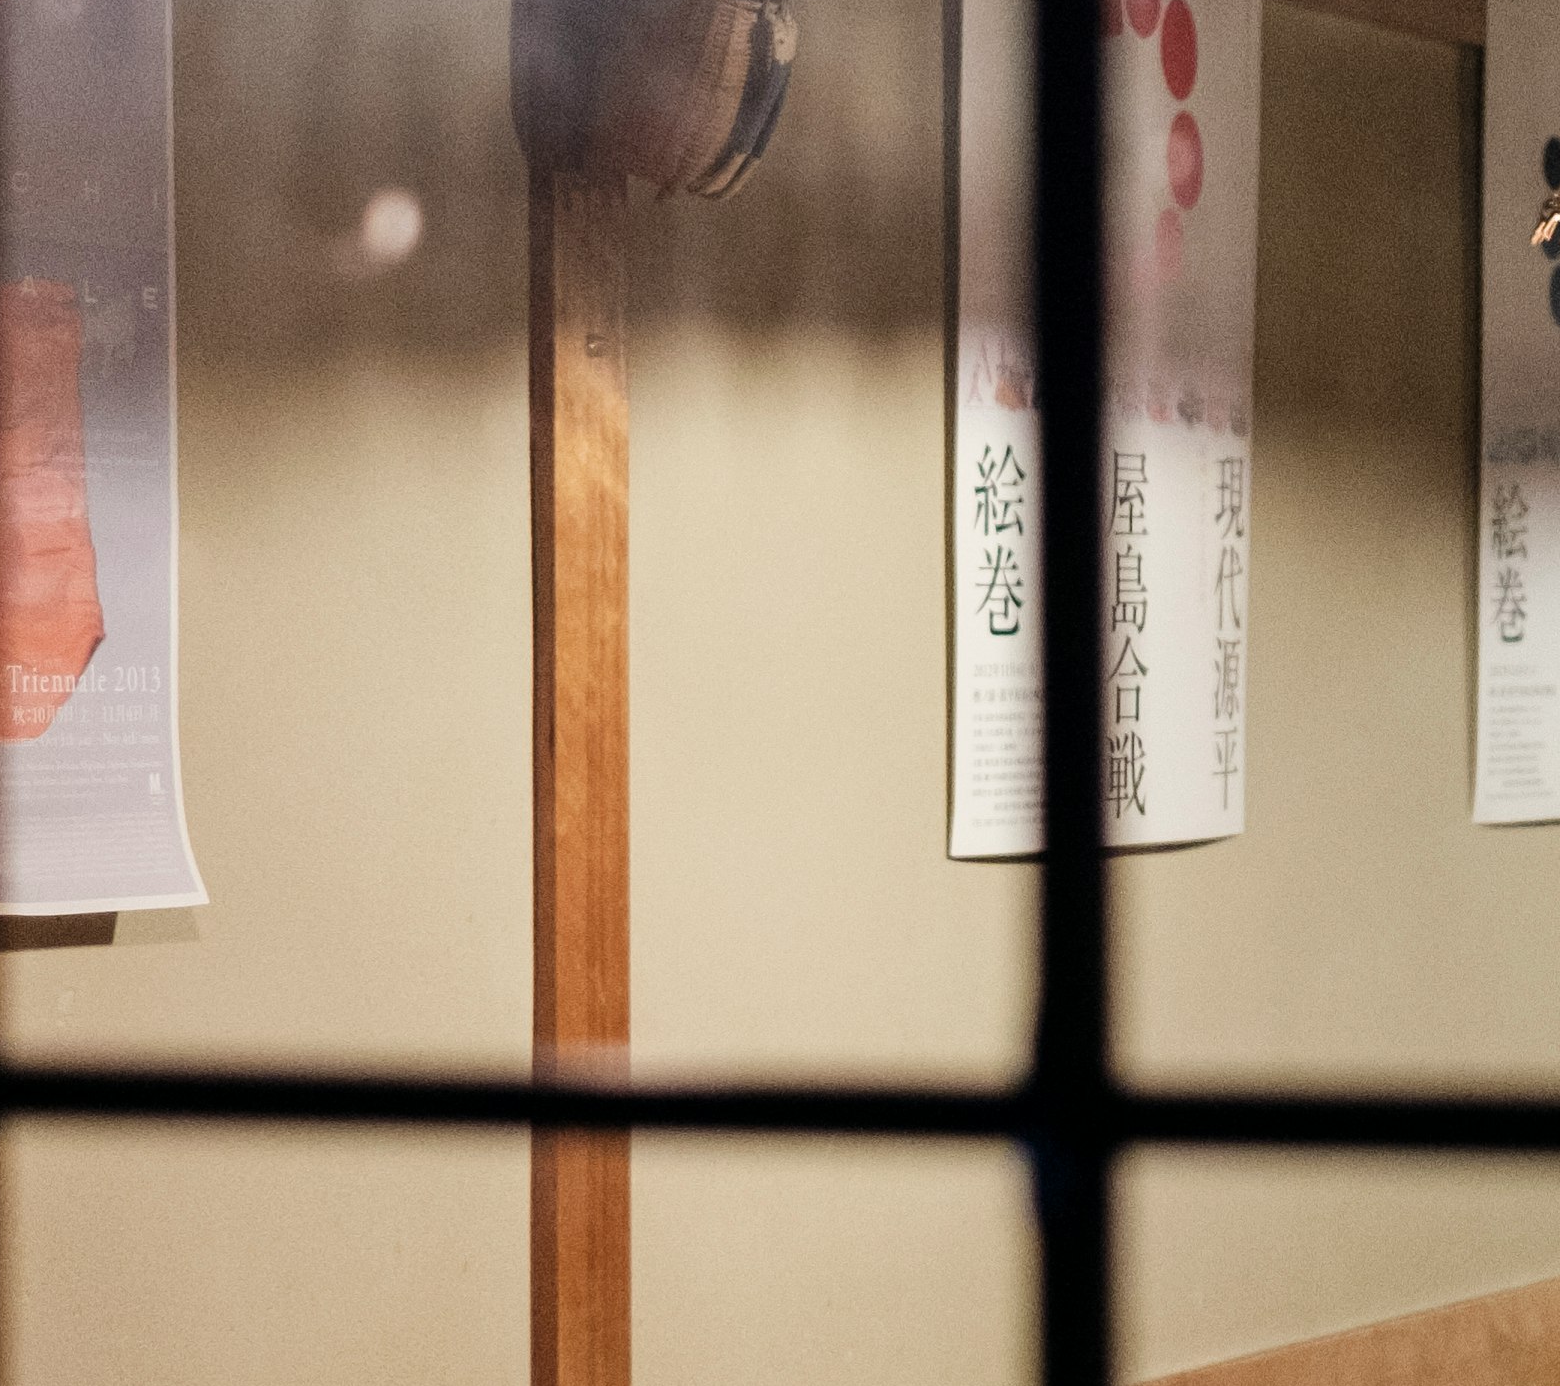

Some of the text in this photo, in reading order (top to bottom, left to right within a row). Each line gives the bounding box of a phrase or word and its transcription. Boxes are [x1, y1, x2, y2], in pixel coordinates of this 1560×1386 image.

[973, 444, 1026, 637] 絵巻
[1106, 449, 1148, 819] 屋島合戦
[1211, 457, 1245, 811] 現代源平
[1492, 483, 1529, 642] 絵巻
[6, 664, 107, 694] Triennale
[114, 665, 161, 693] 2013
